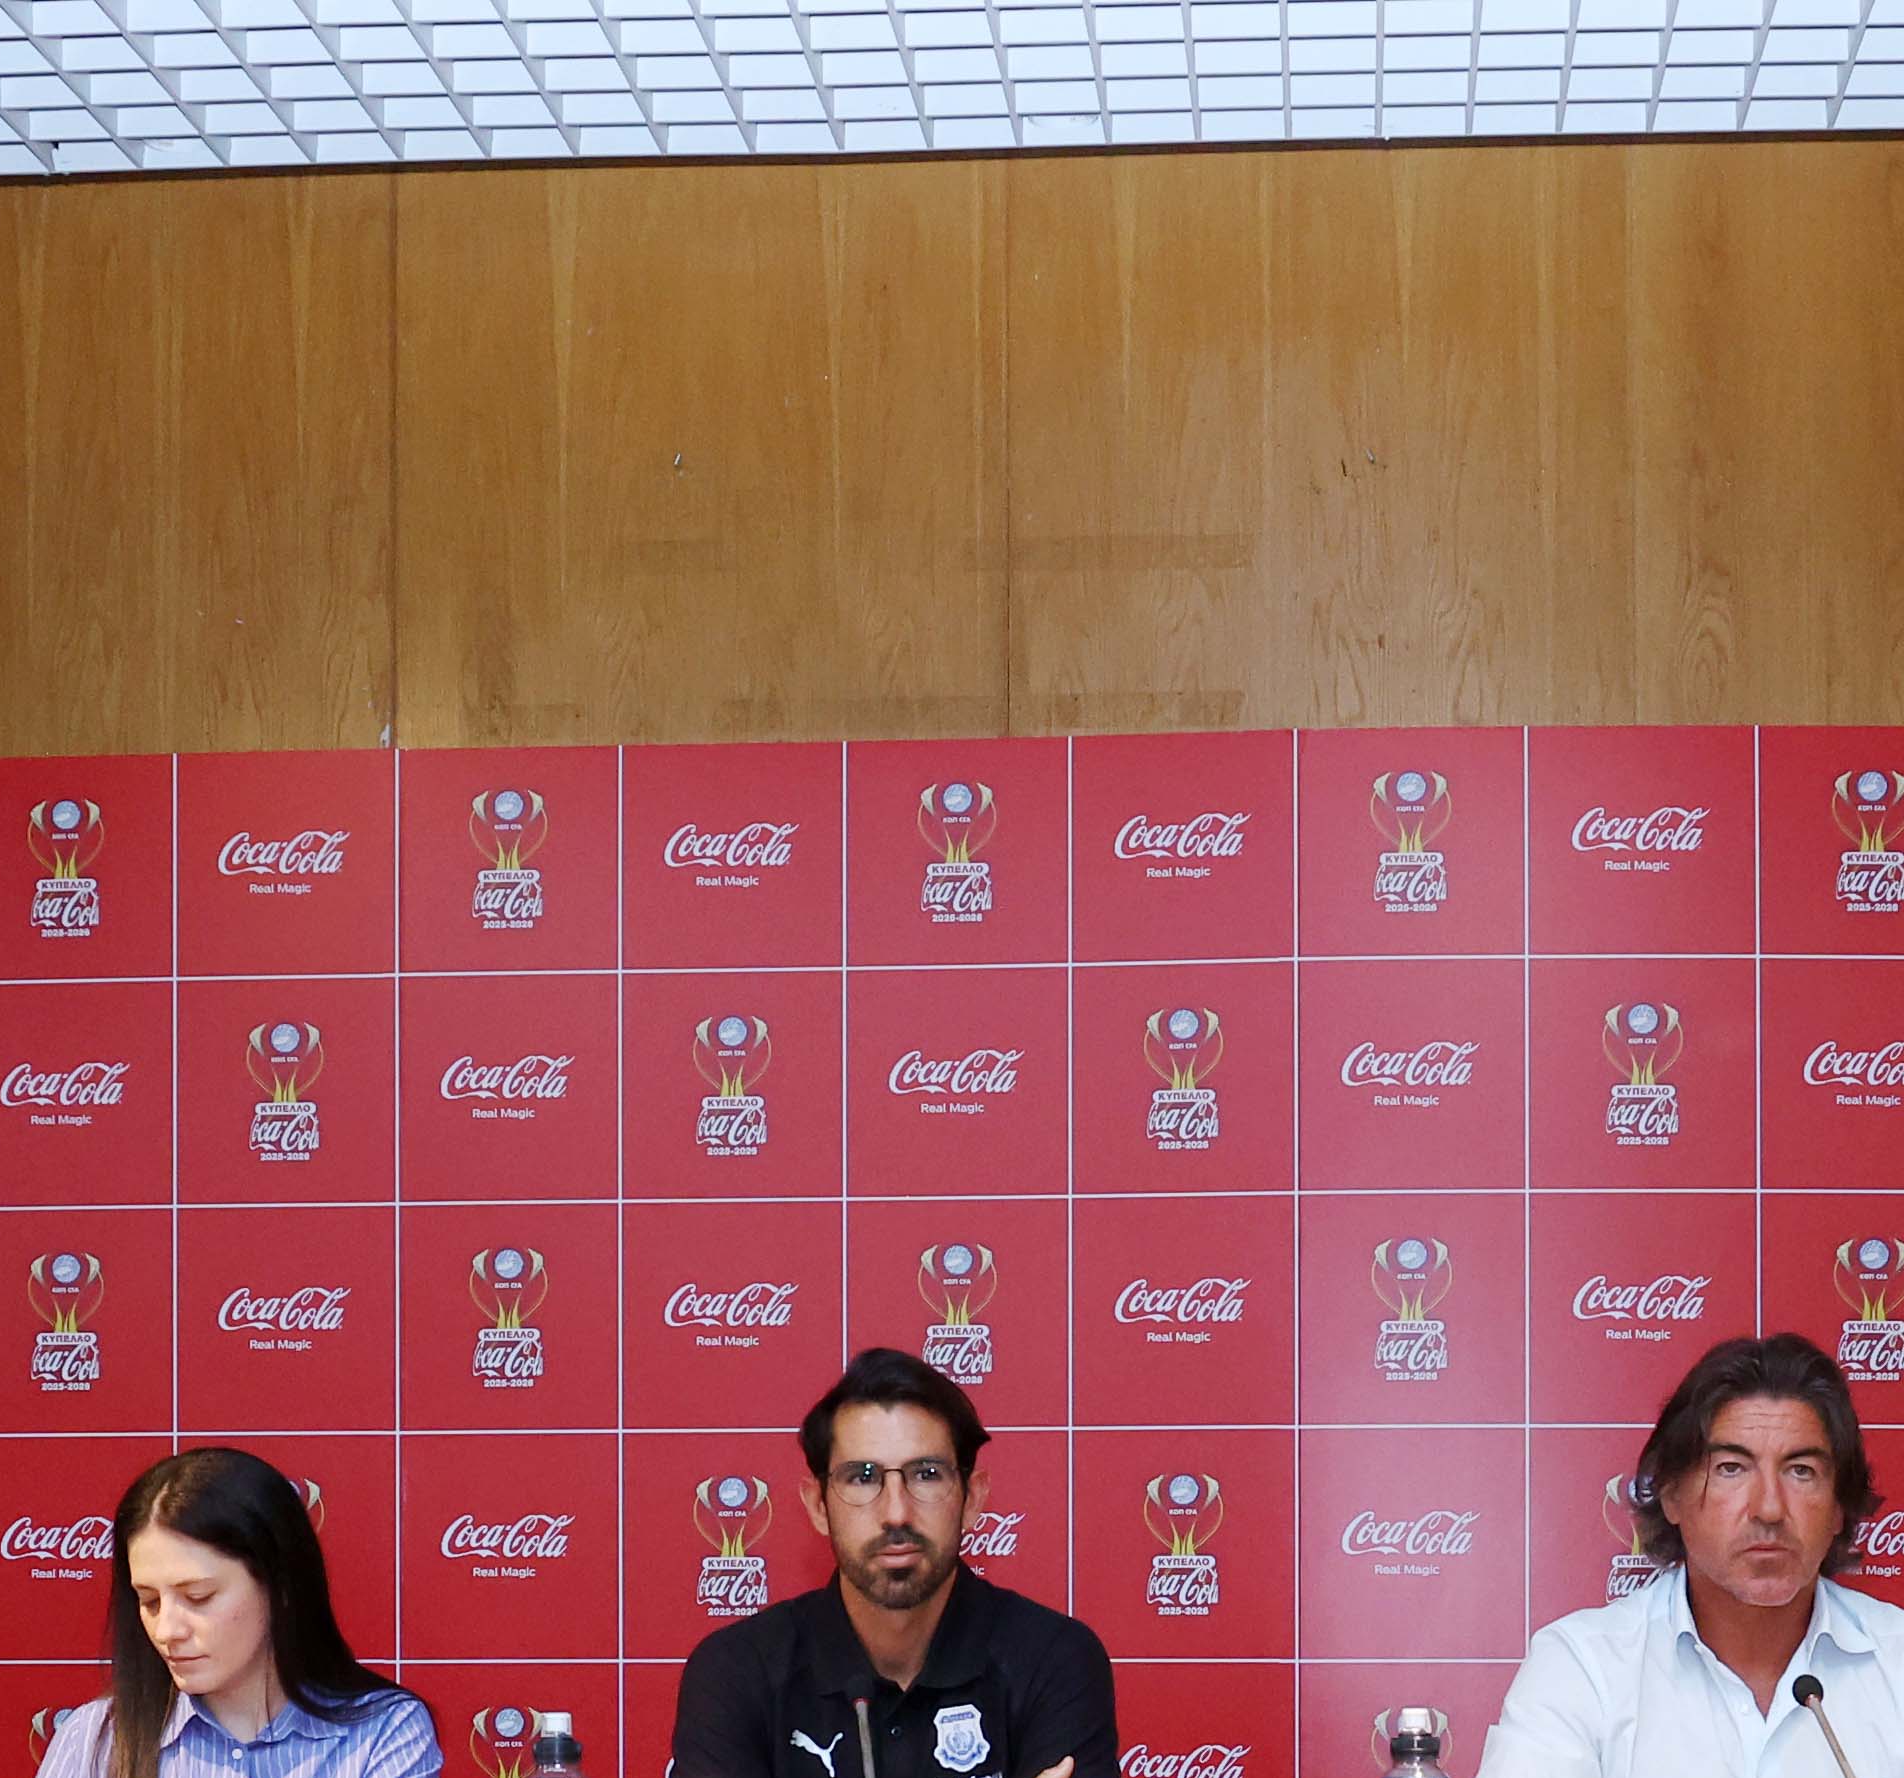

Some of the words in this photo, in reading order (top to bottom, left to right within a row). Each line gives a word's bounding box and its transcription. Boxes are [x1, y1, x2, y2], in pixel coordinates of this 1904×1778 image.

[1115, 813, 1251, 858] Coca-Cola
[1572, 807, 1711, 851] Coca-Cola
[664, 823, 799, 867] Coca-Cola
[218, 831, 350, 875] Coca-Cola
[1385, 854, 1437, 864] ΚΥΠΕΛΛΟ
[1147, 867, 1173, 877] Real
[1176, 867, 1211, 879] Magic
[1605, 860, 1631, 871] Real
[1634, 860, 1669, 873] Magic
[696, 876, 721, 886] Real
[724, 876, 759, 888] Magic
[1374, 863, 1446, 902] Coca-Cola
[249, 883, 274, 894] Real
[277, 883, 311, 896] Magic
[1341, 1042, 1480, 1086] Coca-Cola
[441, 1056, 575, 1099] Coca-Cola
[889, 1050, 1024, 1094] Coca-Cola
[0, 1062, 130, 1106] Coca-Cola
[1617, 1086, 1669, 1096] ΚΥΠΕΛΛΟ
[1374, 1095, 1400, 1106] Real
[1403, 1095, 1439, 1108] Magic
[1837, 1095, 1863, 1106] Real
[1866, 1095, 1901, 1108] Magic
[472, 1108, 497, 1119] Real
[500, 1108, 535, 1121] Magic
[921, 1102, 946, 1113] Real
[949, 1102, 984, 1115] Magic
[1606, 1095, 1678, 1135] Coca-Cola
[31, 1114, 55, 1125] Real
[58, 1114, 92, 1127] Magic
[664, 1283, 799, 1326] Coca-Cola
[1115, 1278, 1251, 1323] Coca-Cola
[1573, 1276, 1712, 1320] Coca-Cola
[218, 1287, 351, 1330] Coca-Cola
[484, 1330, 533, 1340] ΚΥΠΕΛΛΟ
[696, 1335, 721, 1346] Real
[724, 1335, 759, 1348] Magic
[1147, 1331, 1173, 1342] Real
[1176, 1331, 1211, 1344] Magic
[1606, 1329, 1632, 1340] Real
[1635, 1329, 1671, 1342] Magic
[250, 1339, 275, 1350] Real
[278, 1339, 312, 1352] Magic
[473, 1339, 543, 1377] Coca-Cola
[441, 1515, 575, 1558] Coca-Cola
[1342, 1511, 1480, 1554] Coca-Cola
[1158, 1557, 1209, 1567] ΚΥΠΕΛΛΟ
[31, 1568, 56, 1579] Real
[59, 1568, 93, 1581] Magic
[473, 1566, 498, 1577] Real
[501, 1566, 536, 1579] Magic
[1375, 1565, 1401, 1575] Real
[1404, 1565, 1439, 1577] Magic
[1868, 1565, 1901, 1578] Magic
[1147, 1566, 1220, 1605] Coca-Cola
